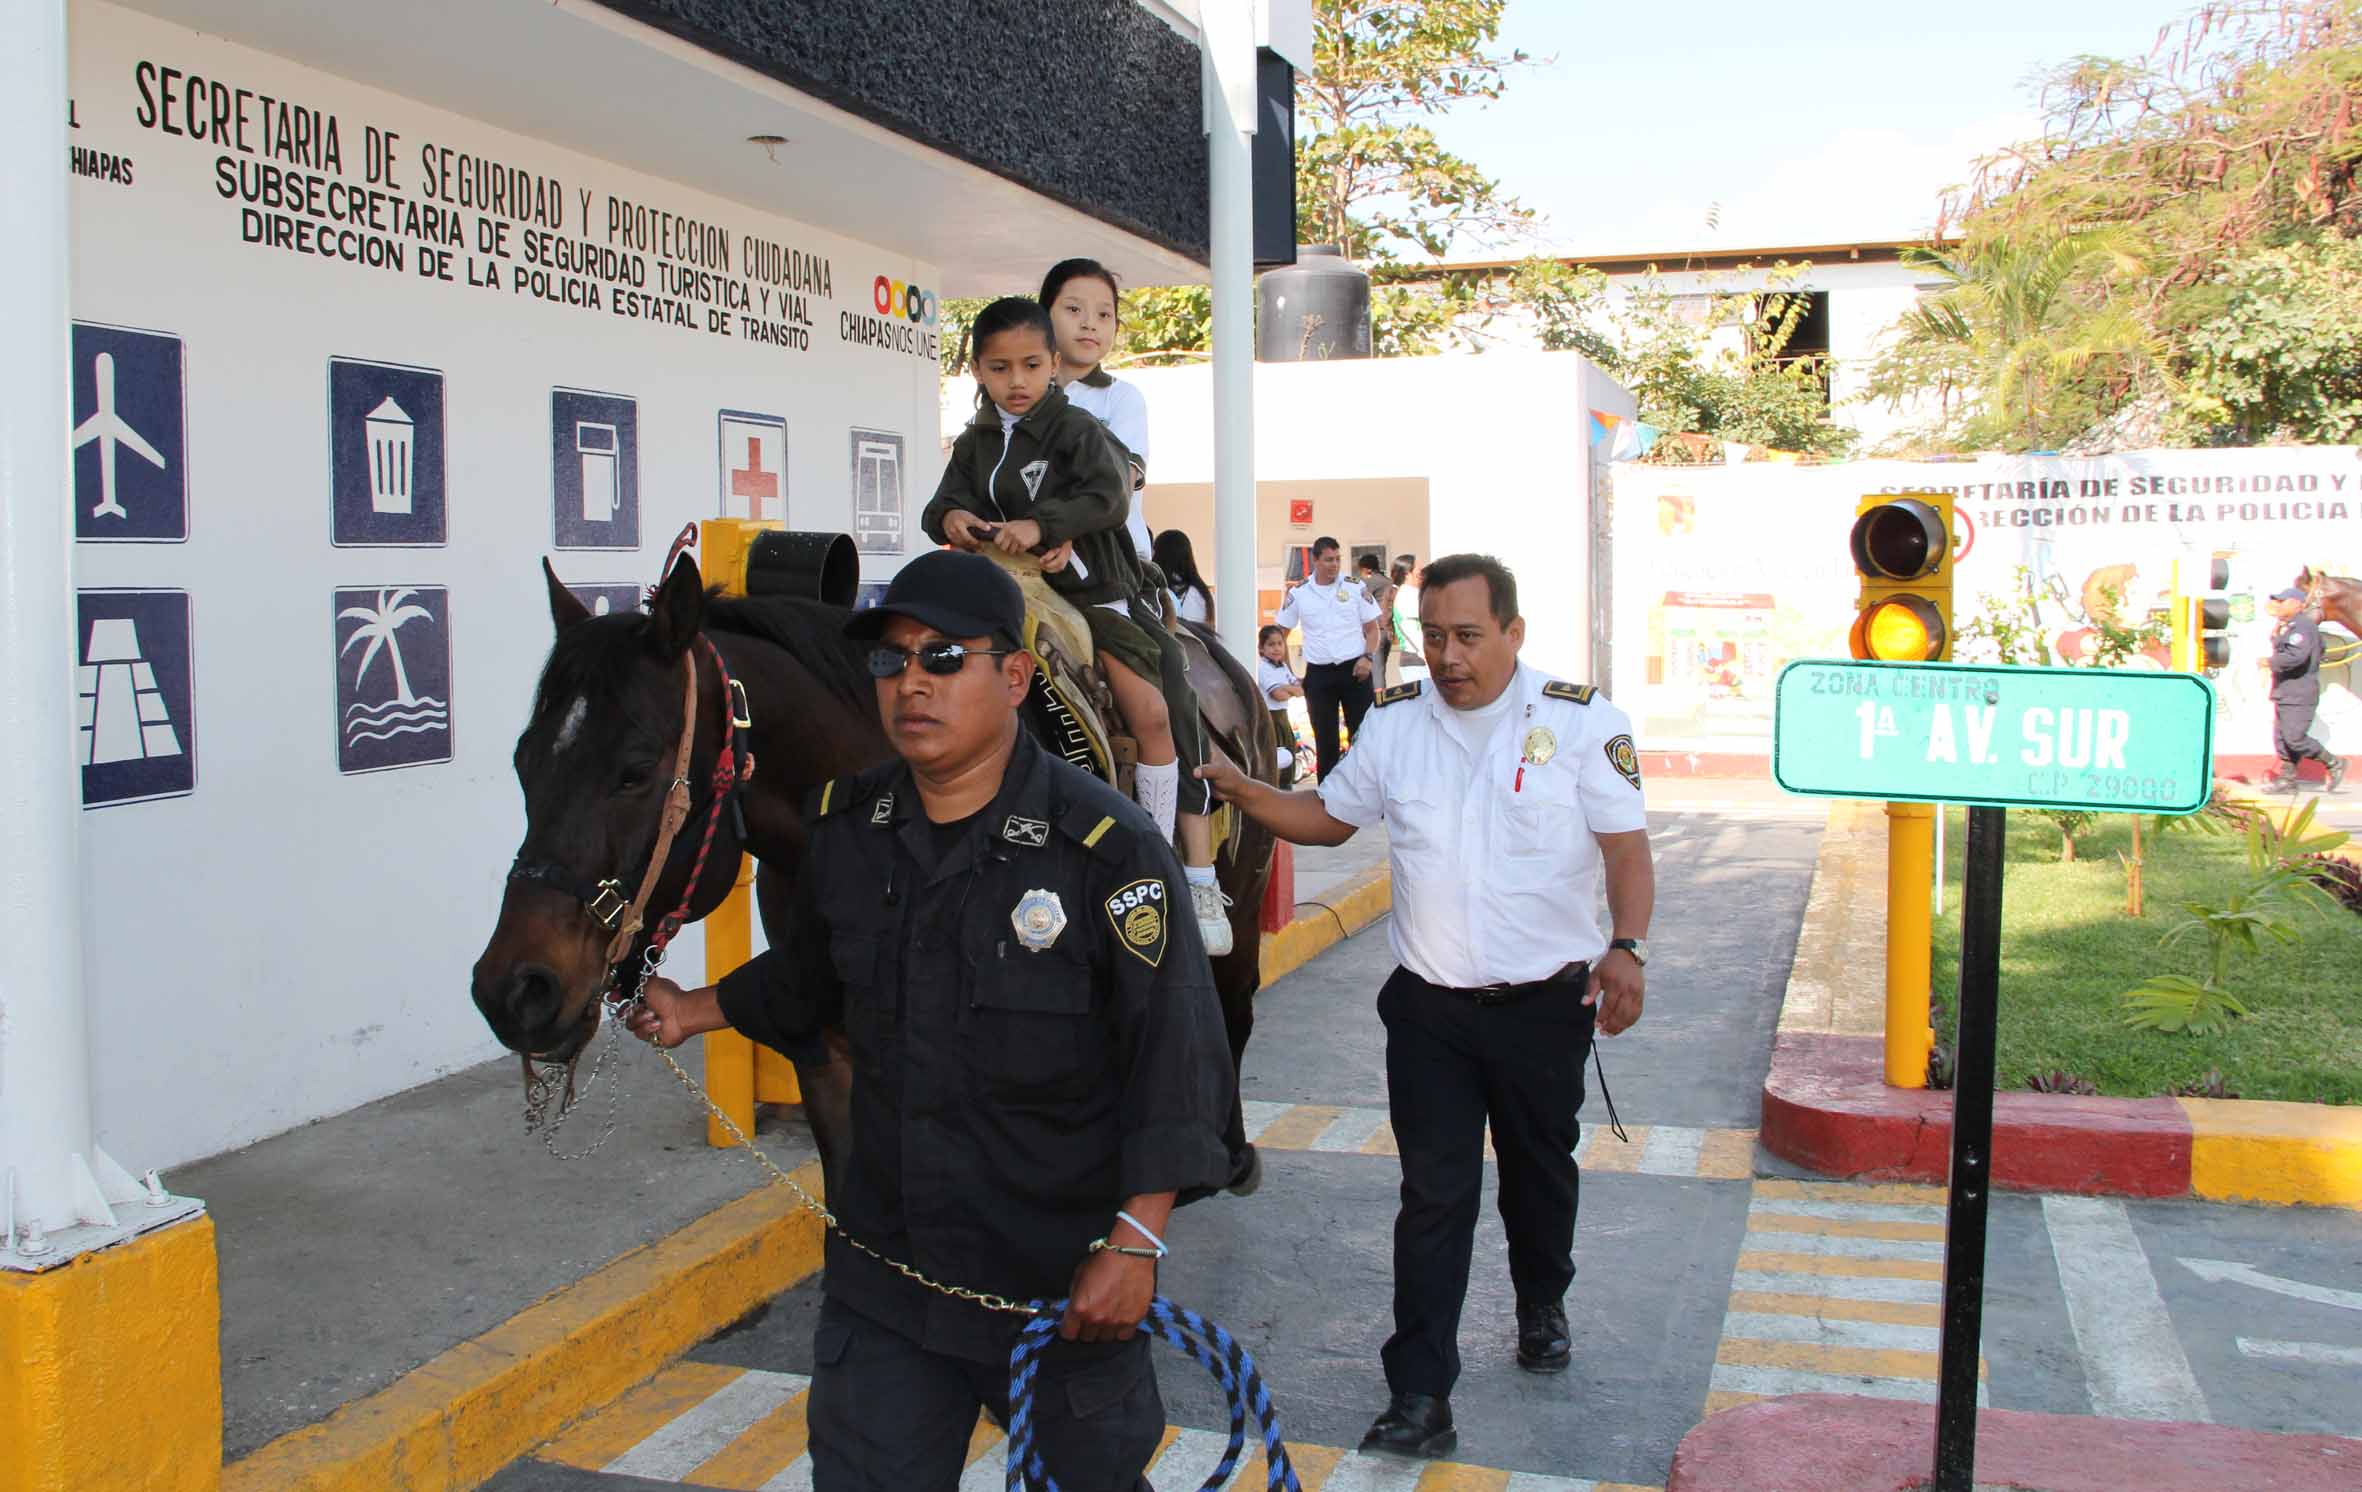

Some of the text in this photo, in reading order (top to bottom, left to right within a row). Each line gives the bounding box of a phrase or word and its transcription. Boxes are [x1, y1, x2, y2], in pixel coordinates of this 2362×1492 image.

[71, 145, 134, 186] HIAPAS
[136, 60, 833, 300] SECRETARIA DE SEGURIDAD Y PROTECCION CIUDADANA
[215, 156, 814, 327] SUBSECRETARIA DE SEGURIDAD TURISTICA Y VIAL
[241, 207, 810, 352] DIRECCION DE LA POLICIA ESTATAL DE TRANSITO
[916, 329, 937, 361] UNE
[2080, 478, 2119, 498] DE
[2128, 474, 2319, 496] SEGURIDAD
[2330, 474, 2347, 492] Y
[2121, 503, 2159, 523] DE
[2168, 503, 2206, 523] LA
[1810, 671, 2001, 702] ZONA CENTRO
[1926, 702, 1999, 765] AV.
[2020, 706, 2130, 769] SUR
[2085, 773, 2177, 801] 29000
[1109, 883, 1162, 916] SSPC
